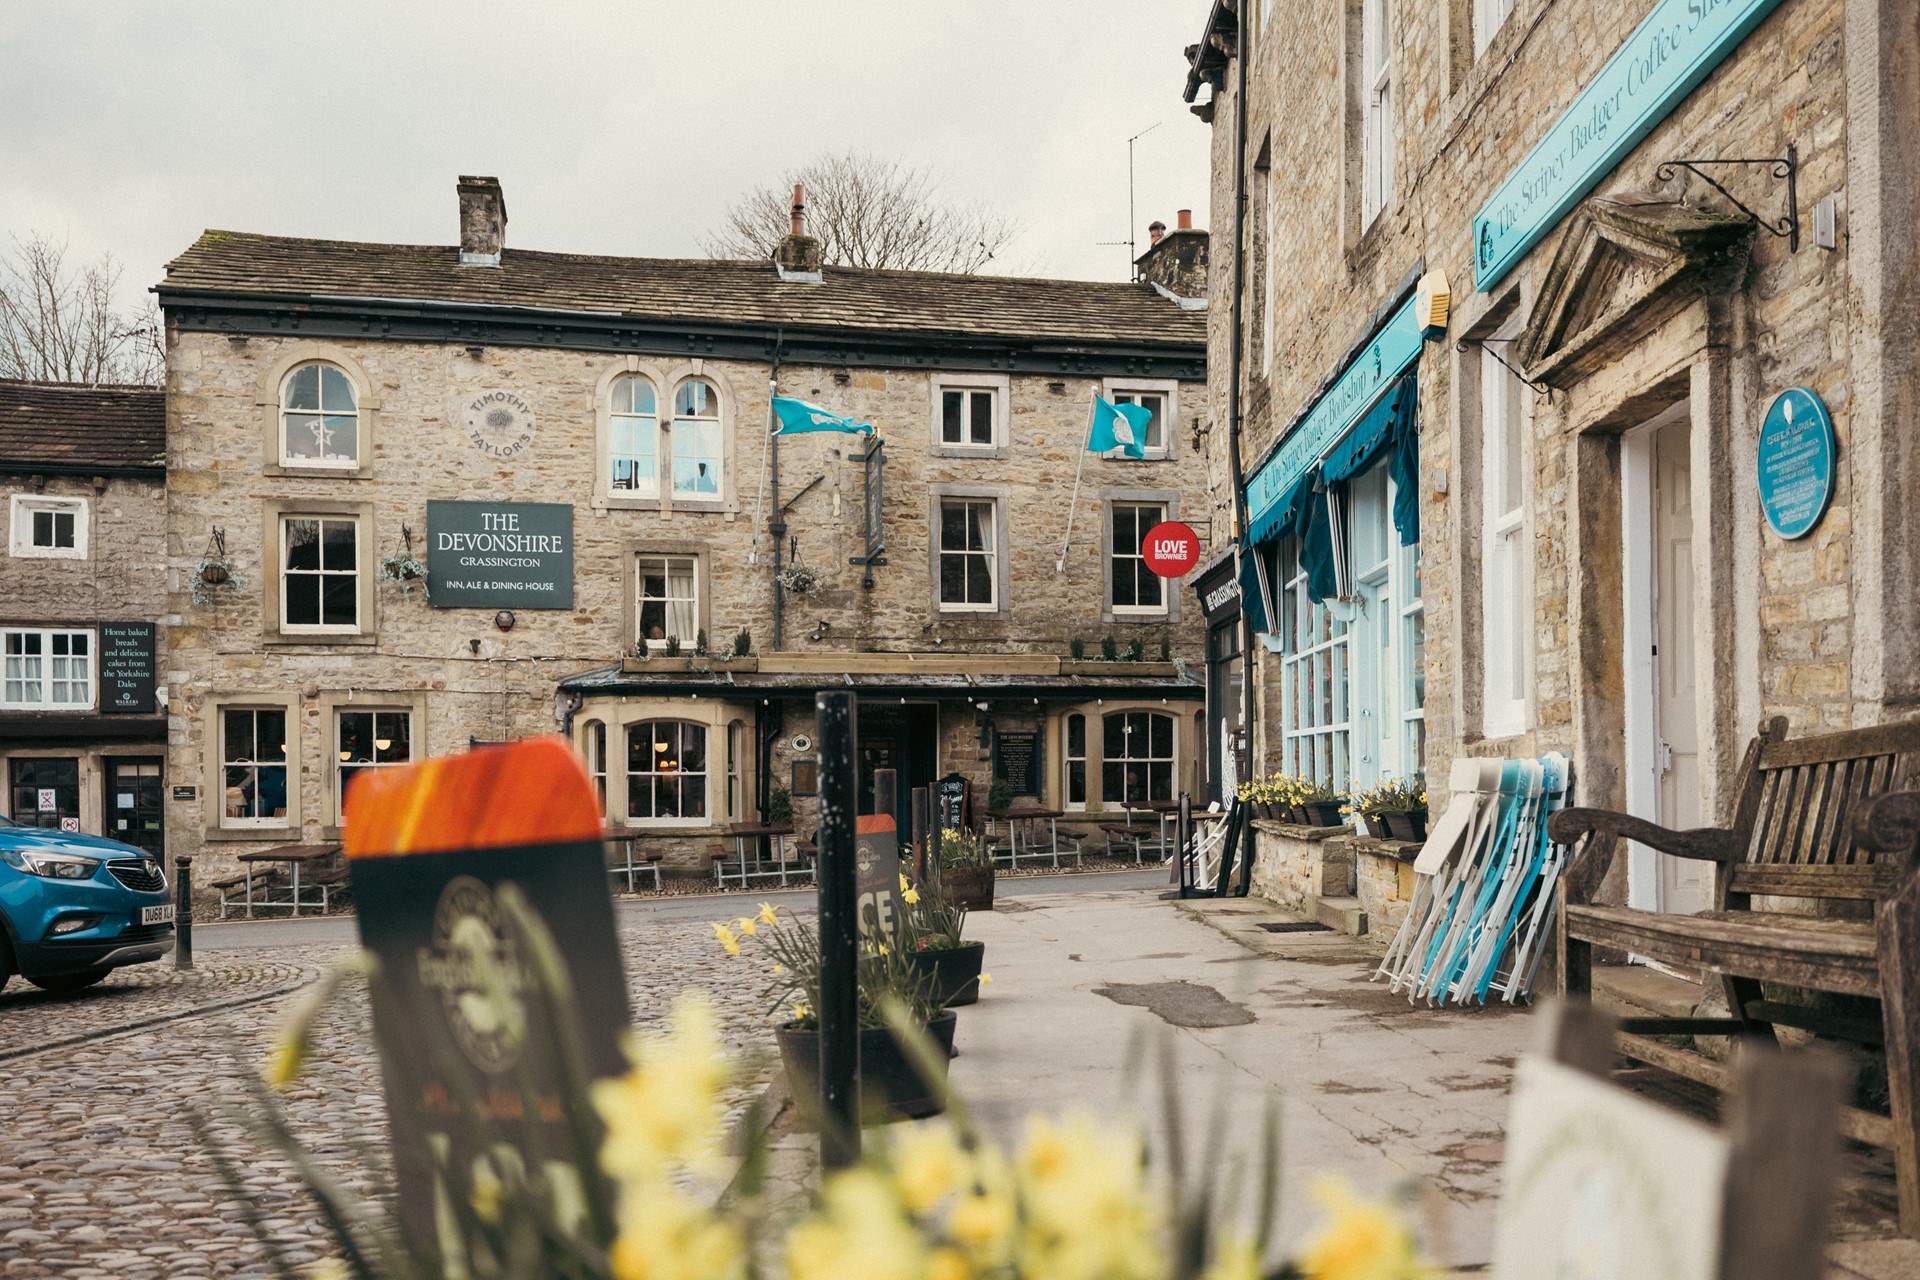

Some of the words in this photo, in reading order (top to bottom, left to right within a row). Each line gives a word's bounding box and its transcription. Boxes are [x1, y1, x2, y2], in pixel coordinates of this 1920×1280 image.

[1496, 204, 1519, 238] The
[1522, 149, 1567, 211] Stripey
[1569, 85, 1623, 160] Badger
[1626, 24, 1682, 97] Coffee
[470, 392, 530, 413] TIMOTHY
[1271, 461, 1282, 486] The
[1282, 444, 1303, 474] Stripey
[1303, 414, 1328, 451] Badger
[1328, 372, 1366, 423] Bookshop
[470, 430, 531, 457] TAYLOR'S
[481, 513, 520, 531] THE
[438, 532, 563, 553] DEVONSHIRE
[1154, 540, 1188, 553] LOVE
[460, 556, 541, 567] GRASSINGTON
[446, 580, 465, 590] INN,
[466, 581, 482, 590] ALE
[483, 581, 490, 590] &
[491, 581, 523, 591] DINING
[525, 581, 555, 591] HOUSE
[104, 628, 126, 636] Home
[127, 628, 149, 636] baked
[104, 649, 118, 657] and
[119, 649, 149, 657] delicious
[107, 659, 127, 667] cakes
[128, 659, 146, 667] from
[103, 669, 115, 678] the
[117, 669, 150, 678] Yorkshire
[117, 680, 137, 688] Dales
